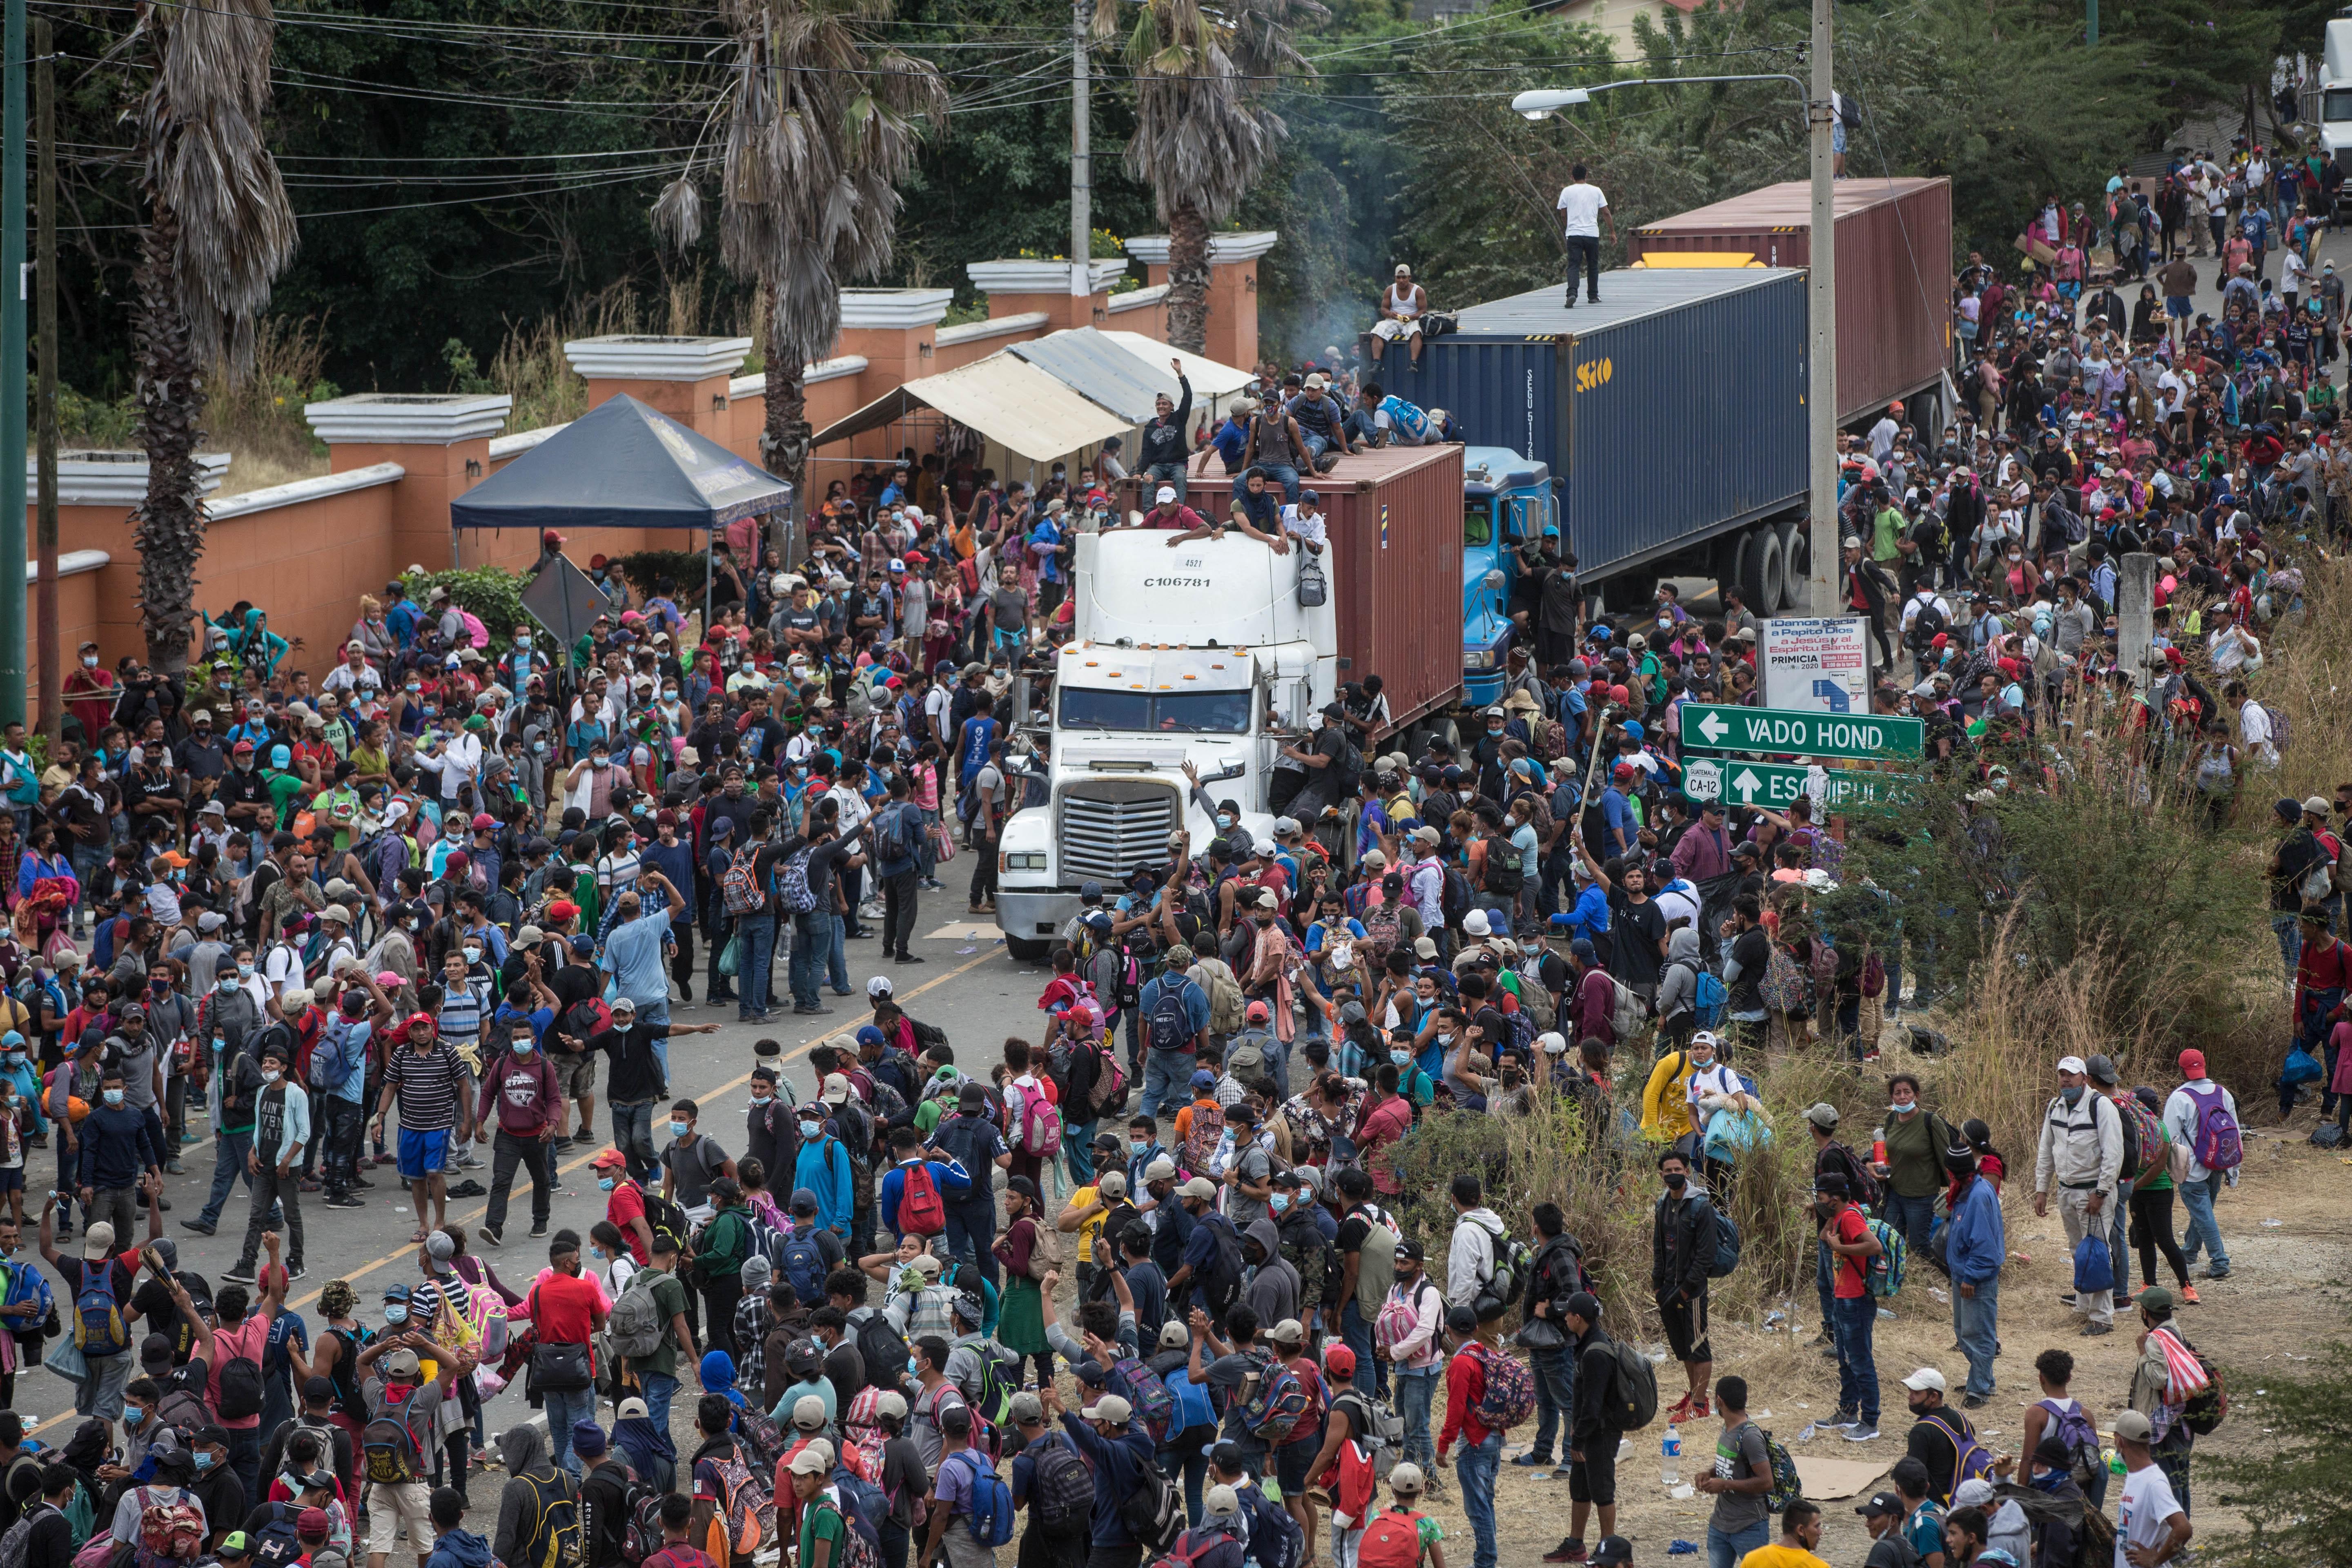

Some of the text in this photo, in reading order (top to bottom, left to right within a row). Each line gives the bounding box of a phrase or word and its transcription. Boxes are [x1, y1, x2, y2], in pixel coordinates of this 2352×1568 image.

[1144, 578, 1210, 587] C106781
[1822, 618, 1857, 627] gloria
[1782, 628, 1823, 637] Papito
[1791, 636, 1829, 644] Jesús
[1769, 644, 1819, 654] Espíritu
[1771, 655, 1818, 664] PRIMICIA
[1745, 717, 1883, 750] VADO HOND
[1690, 779, 1716, 793] CA-12
[1620, 909, 1640, 922] STK
[1387, 1008, 1398, 1026] PAZ
[505, 1079, 535, 1089] STATE
[1049, 1127, 1057, 1137] NIKE
[178, 1323, 189, 1352] BARCELONA
